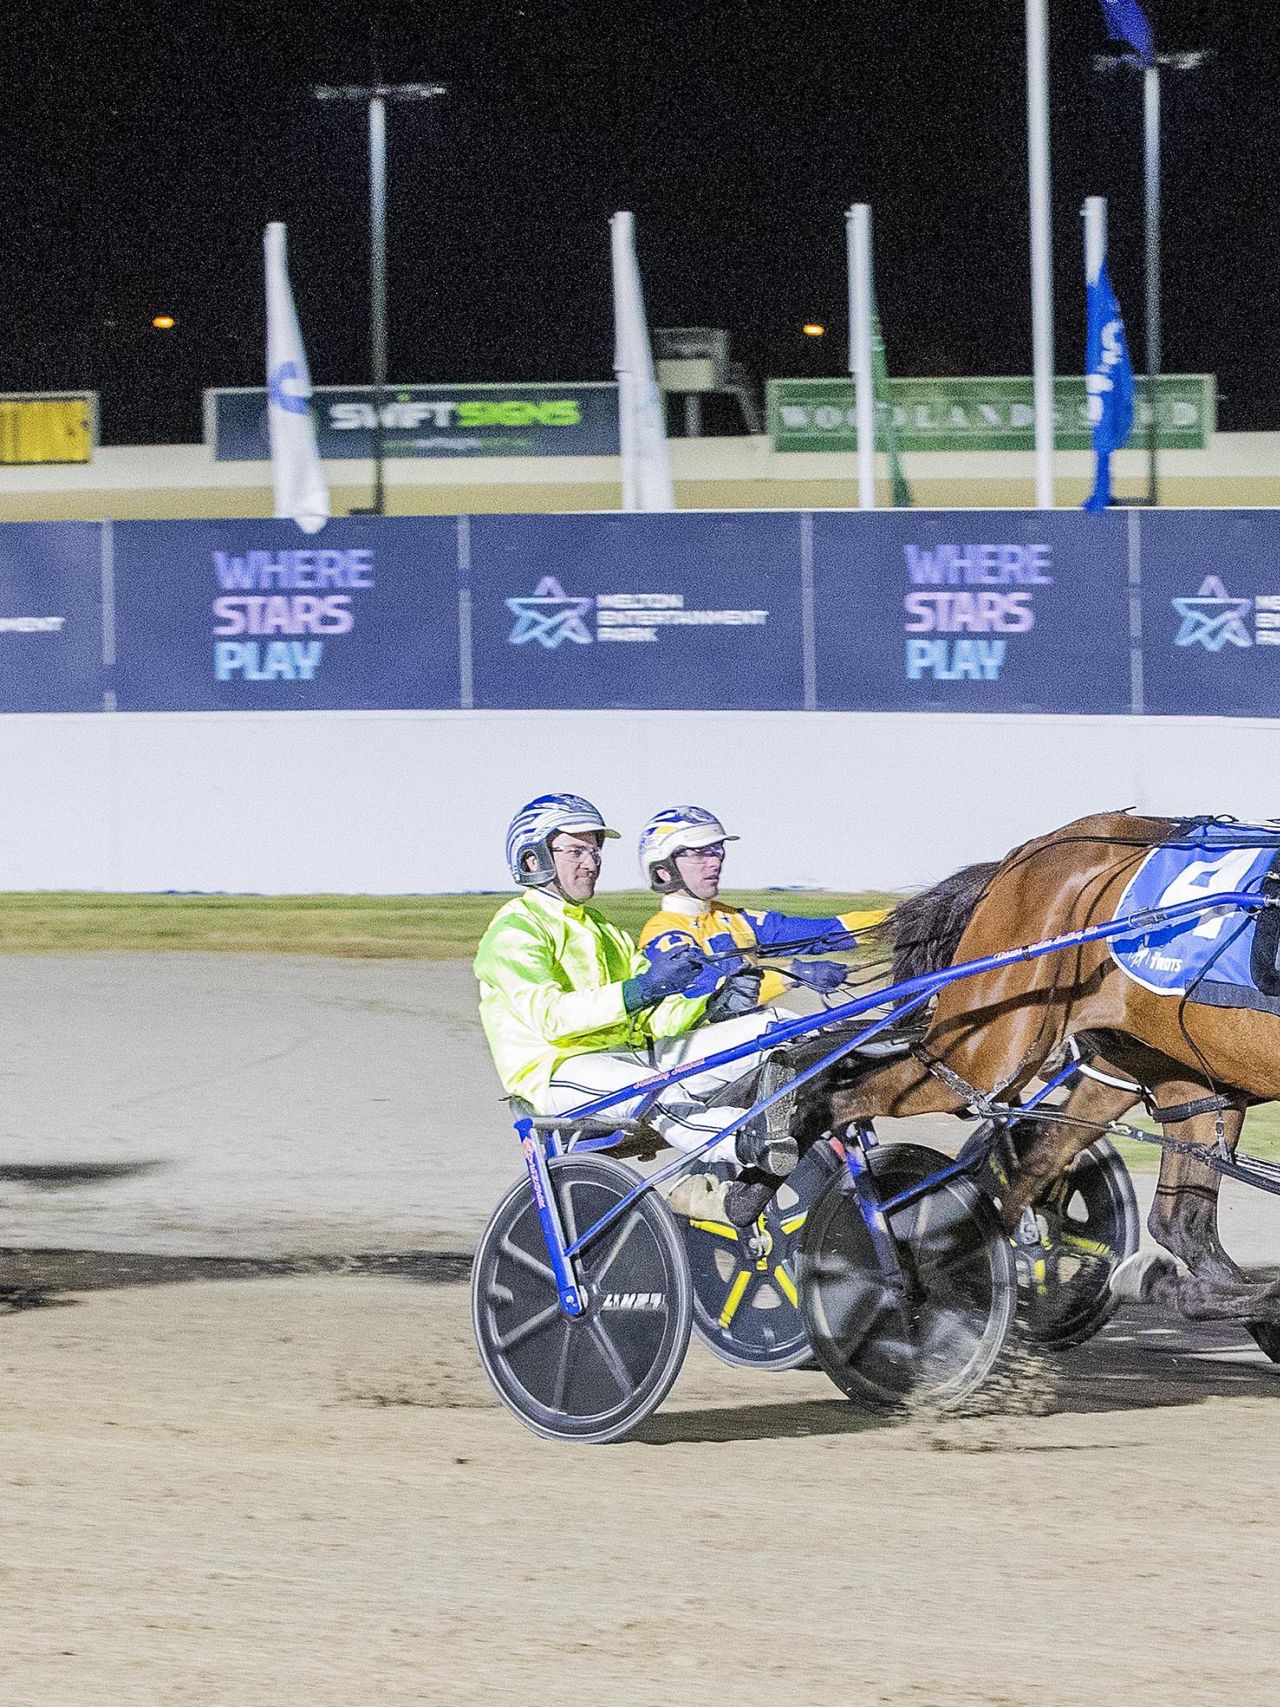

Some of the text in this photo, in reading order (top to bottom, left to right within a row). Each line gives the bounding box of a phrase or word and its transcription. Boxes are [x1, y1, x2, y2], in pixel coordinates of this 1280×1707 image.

[214, 549, 374, 589] WHERE
[903, 544, 1053, 584] WHERE
[212, 594, 354, 635] STARS
[904, 591, 1034, 632] STARS
[214, 641, 323, 681] PLAY
[906, 639, 1006, 679] PLAY
